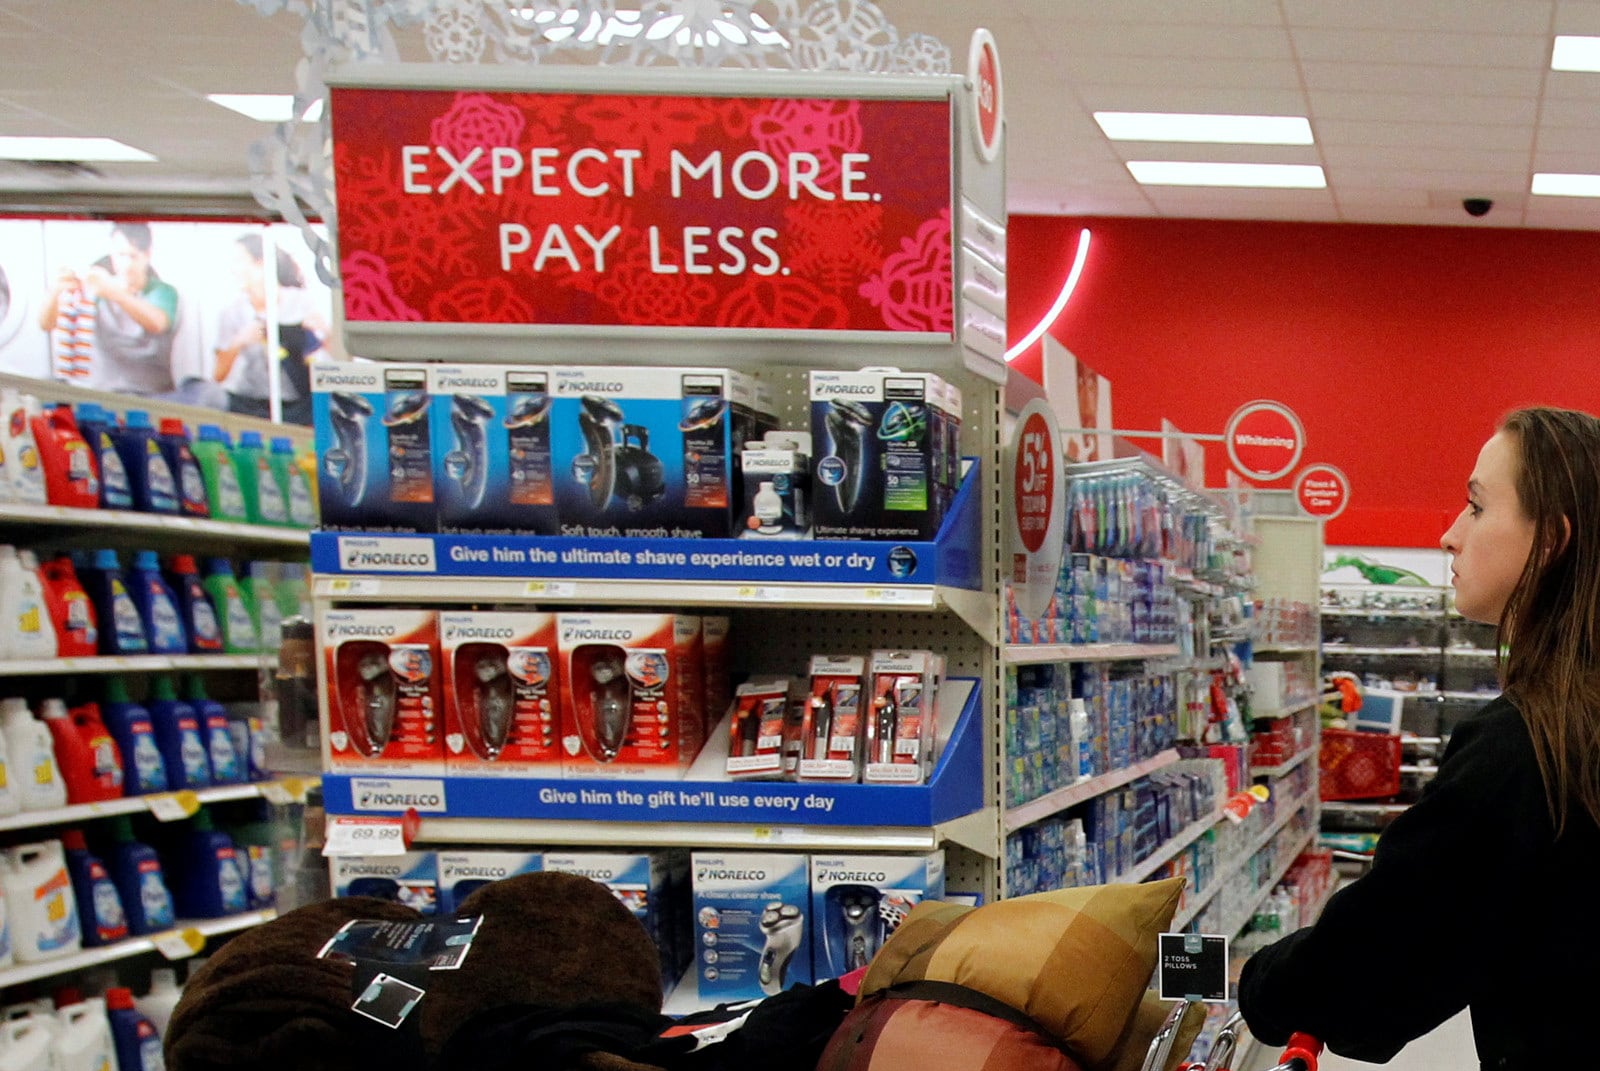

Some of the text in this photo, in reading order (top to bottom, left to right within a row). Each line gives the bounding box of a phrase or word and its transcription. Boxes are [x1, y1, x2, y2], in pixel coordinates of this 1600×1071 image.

[402, 146, 882, 202] EXPECT MORE.
[500, 224, 791, 276] PAY LESS.
[326, 375, 376, 385] NORELCO
[447, 377, 498, 388] NORELCO
[568, 381, 623, 393] NORELCO
[825, 385, 875, 395] NORELCO
[1236, 434, 1294, 449] Whitening
[561, 524, 585, 537] Soft
[626, 527, 668, 538] smooth
[671, 527, 703, 539] shave
[816, 526, 919, 536] Ultimate shaving experience
[361, 553, 429, 565] NORELCO
[451, 546, 875, 571] Give him the ultimate shave experience wet or dry
[338, 624, 394, 636] NORELCO
[457, 627, 514, 638] NORELCO
[575, 629, 632, 640] NORELCO
[373, 794, 439, 805] NORELCO
[540, 788, 835, 812] Give him the gift he'll use every day
[352, 827, 400, 840] 69.99
[349, 865, 400, 875] NORELCO
[455, 866, 506, 877] NORELCO
[709, 869, 766, 880] NORELCO
[829, 871, 885, 882] NORELCO
